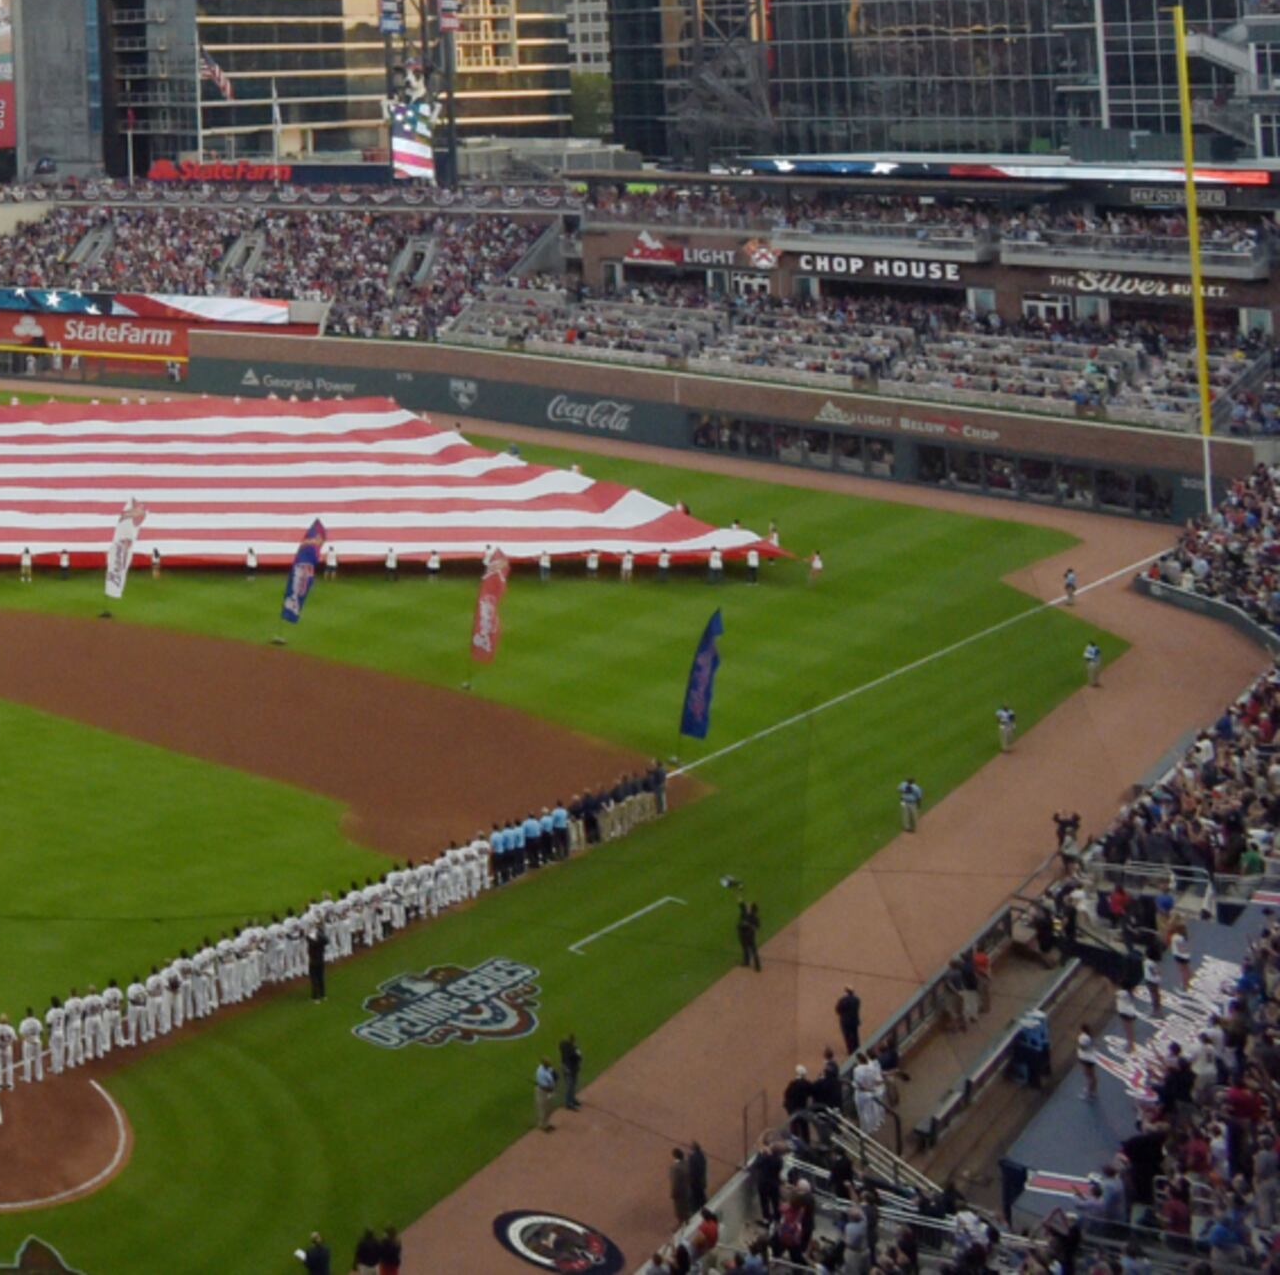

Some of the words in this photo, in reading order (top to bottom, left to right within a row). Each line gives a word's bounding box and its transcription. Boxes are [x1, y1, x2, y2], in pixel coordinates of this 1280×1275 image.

[683, 247, 737, 265] LIGHT
[800, 255, 864, 274] CHOP
[873, 260, 961, 280] HOUSE
[1050, 275, 1075, 288] THE
[1077, 270, 1169, 296] Silver
[1171, 283, 1228, 298] BULET
[262, 374, 314, 392] Georgia
[315, 377, 357, 393] Power
[351, 991, 471, 1048] OPENING
[445, 958, 539, 1002] SERIES
